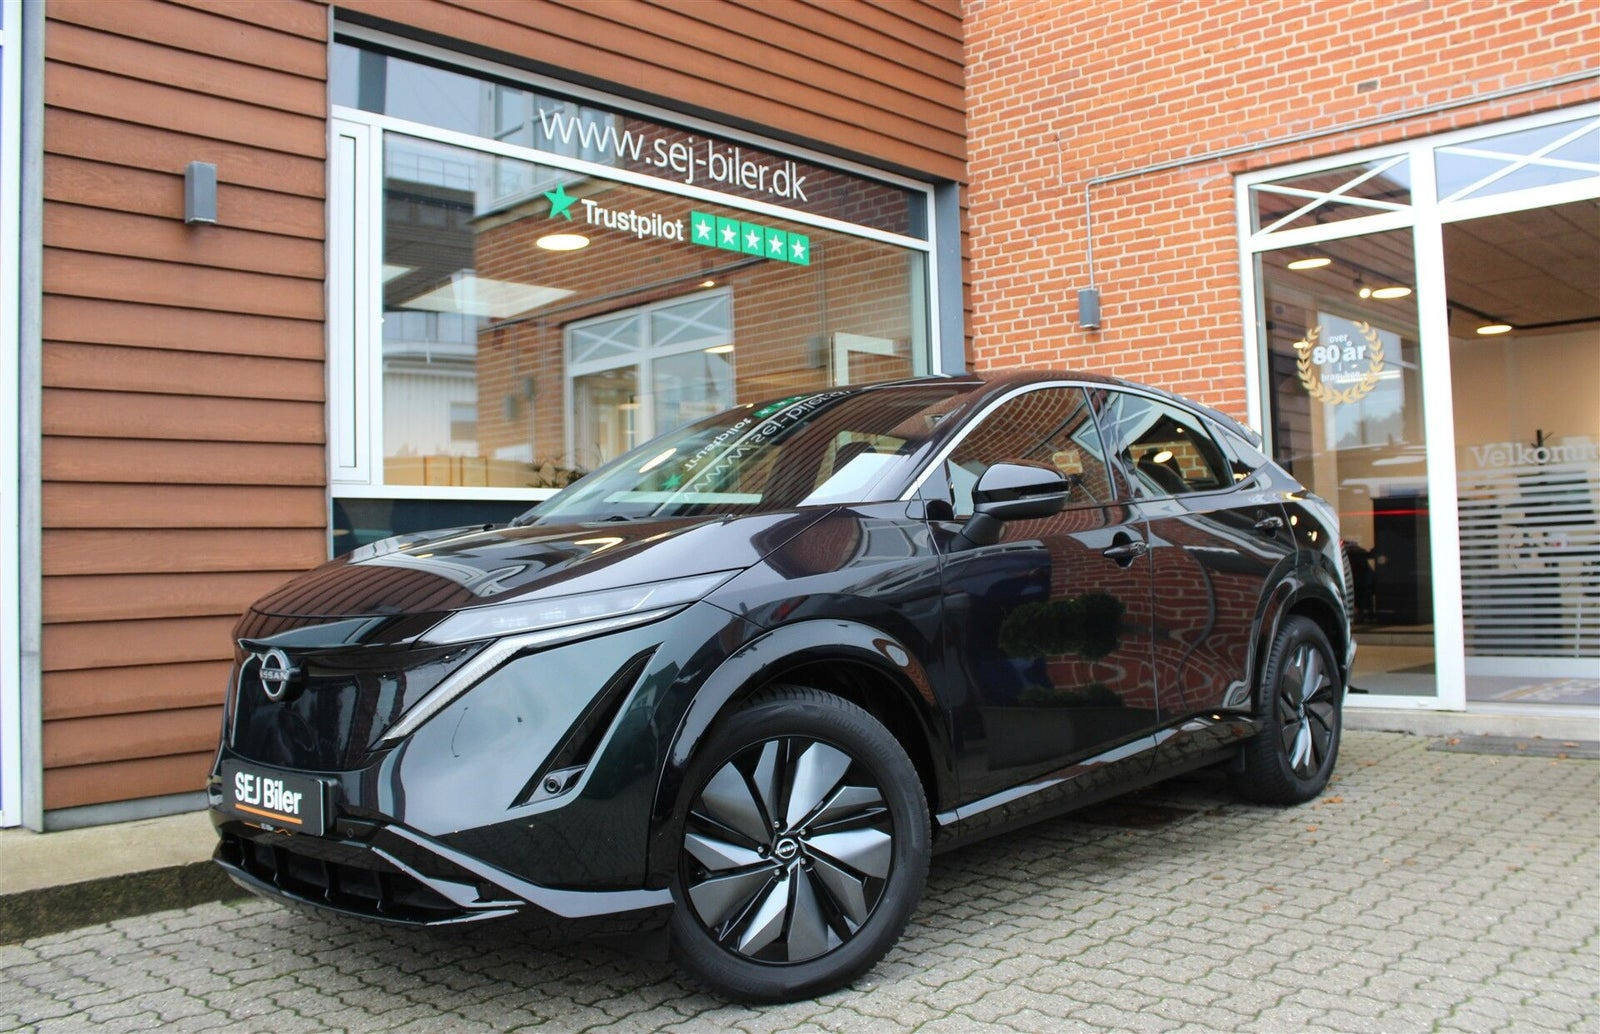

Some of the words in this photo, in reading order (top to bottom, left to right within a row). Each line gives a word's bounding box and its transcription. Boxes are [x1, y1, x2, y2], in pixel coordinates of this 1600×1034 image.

[538, 108, 808, 203] www.sej-biler.dk
[581, 198, 684, 241] Trustpilot
[1313, 344, 1340, 365] 80
[1342, 340, 1367, 362] år
[1329, 334, 1348, 343] over
[235, 771, 261, 805] SEJ
[263, 778, 302, 815] Biler
